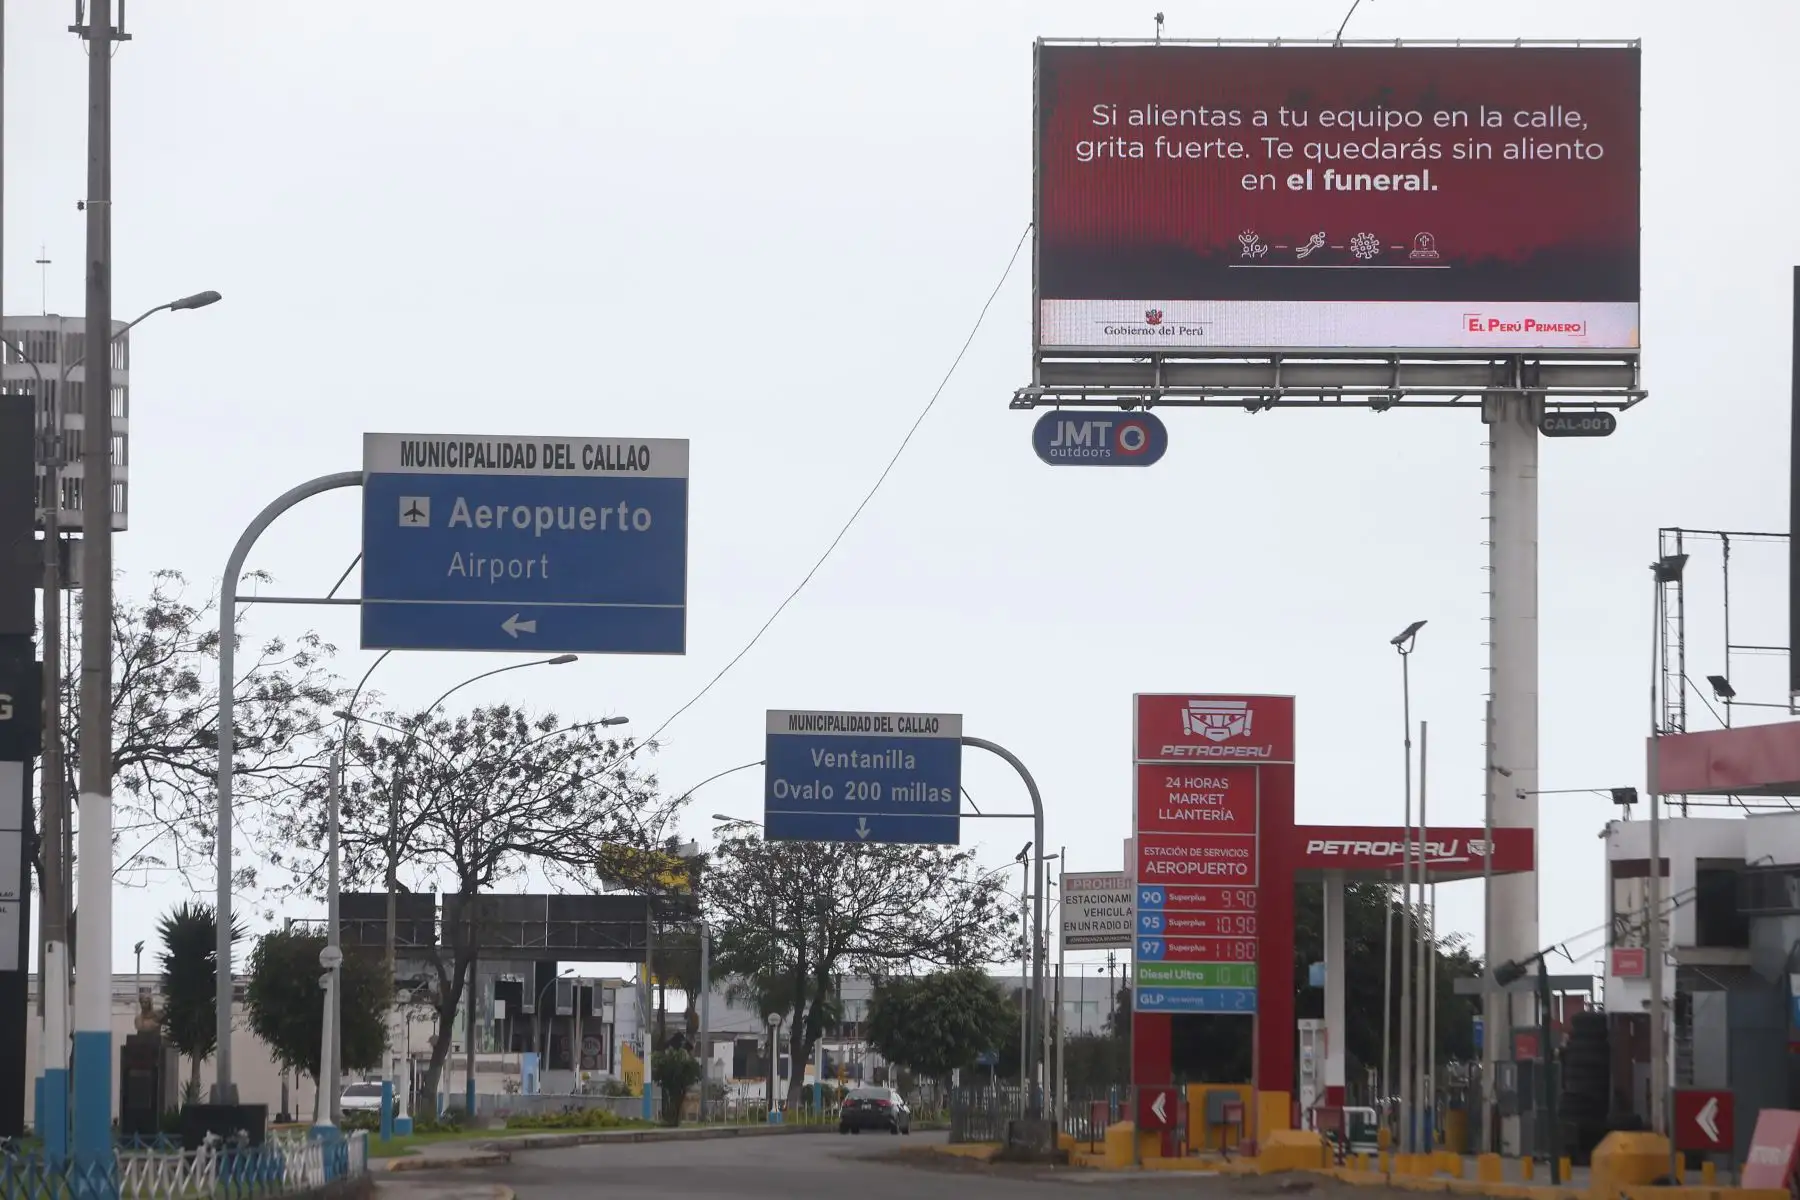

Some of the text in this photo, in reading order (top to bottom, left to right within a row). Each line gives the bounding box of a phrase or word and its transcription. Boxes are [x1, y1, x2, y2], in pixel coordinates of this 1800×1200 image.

[1092, 103, 1589, 132] Si alientas a tu equipo en la calle,
[1076, 135, 1604, 163] grita fuerte. Te quedarás sin aliento
[1241, 168, 1438, 192] en el funeral.
[1104, 326, 1204, 336] Gobierno del Perú
[1544, 418, 1610, 430] CAL-001
[1050, 421, 1113, 447] JMT
[401, 441, 651, 472] MUNICIPALIDAD DEL CALLAO
[1050, 447, 1111, 457] outdoors
[448, 497, 652, 537] Aeropuerto
[447, 551, 548, 585] Airport
[788, 714, 939, 734] MUNICIPALIDAD DEL CALLAO
[811, 748, 916, 770] Ventanilla
[1165, 776, 1229, 789] 24 HORAS
[773, 779, 952, 802] Ovalo 200 millas
[1169, 793, 1224, 805] MARKET
[1158, 807, 1234, 821] LLANTERÍA
[1144, 846, 1249, 858] ESTACIÓN DE SERVICIOS
[1145, 861, 1248, 876] AEROPUERTO
[1142, 892, 1161, 903] 90
[1169, 893, 1206, 902] Superplus
[1064, 921, 1077, 931] EN
[1078, 921, 1091, 930] UN
[1092, 920, 1121, 931] RADIO
[1142, 917, 1160, 928] 95
[1168, 918, 1206, 927] Superplus
[1142, 941, 1160, 953] 97
[1168, 943, 1206, 952] Superplus
[1140, 968, 1173, 979] Diesel
[1140, 994, 1164, 1005] GLP
